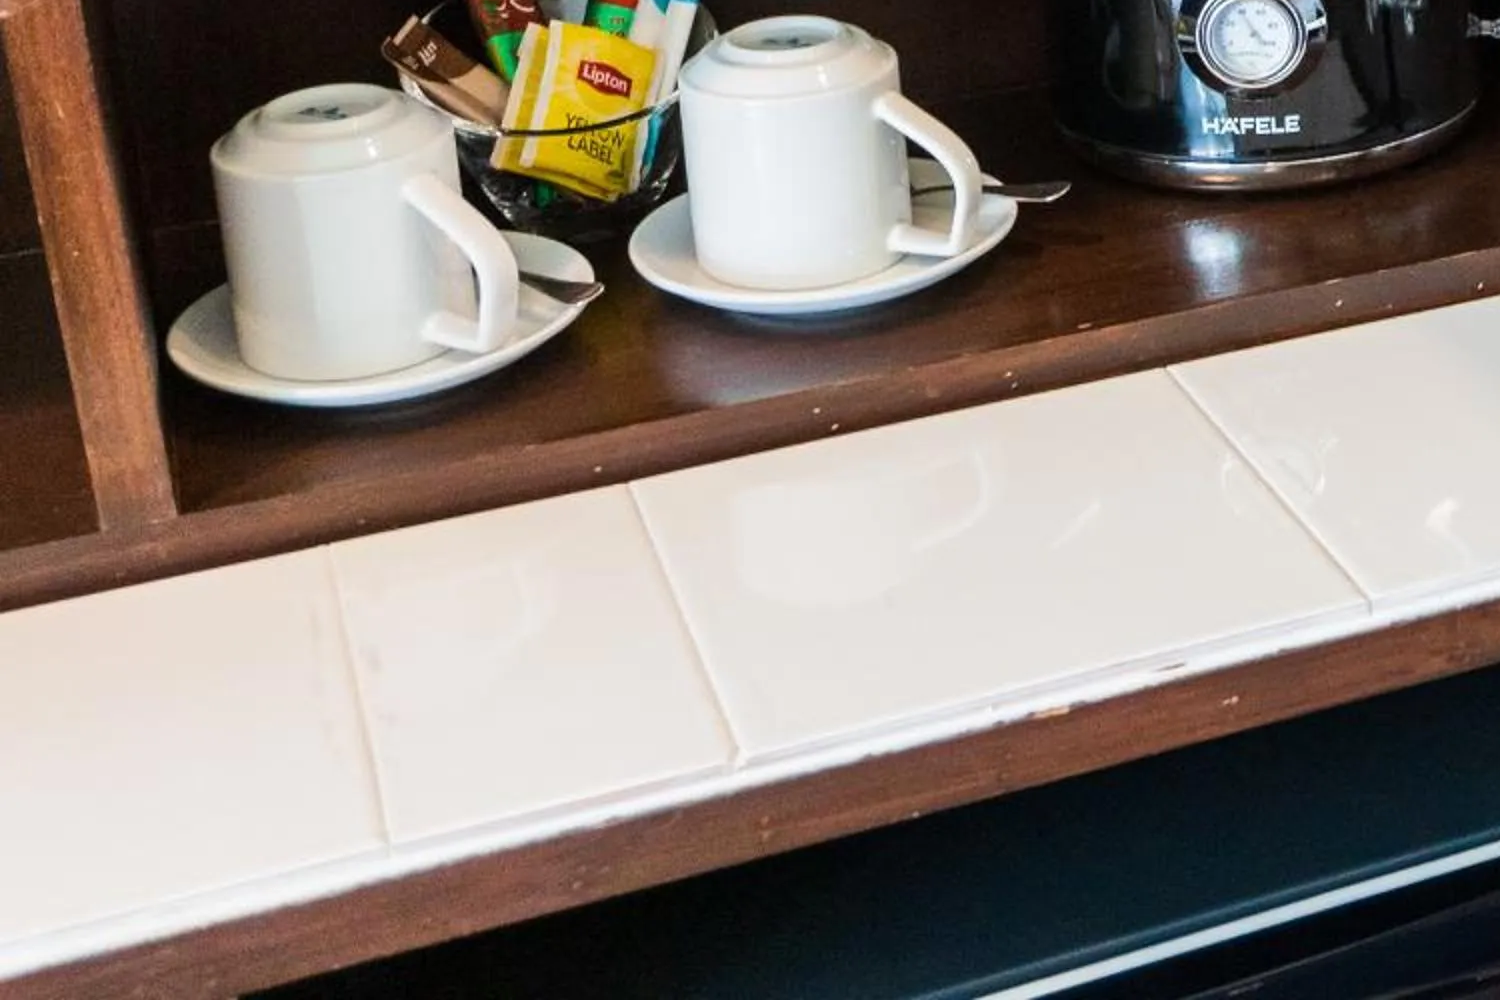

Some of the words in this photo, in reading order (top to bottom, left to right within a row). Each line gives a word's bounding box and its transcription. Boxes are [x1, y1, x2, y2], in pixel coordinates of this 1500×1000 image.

[582, 63, 629, 93] Lipton
[1201, 114, 1301, 136] HÄFELE
[567, 135, 614, 165] LABEL
